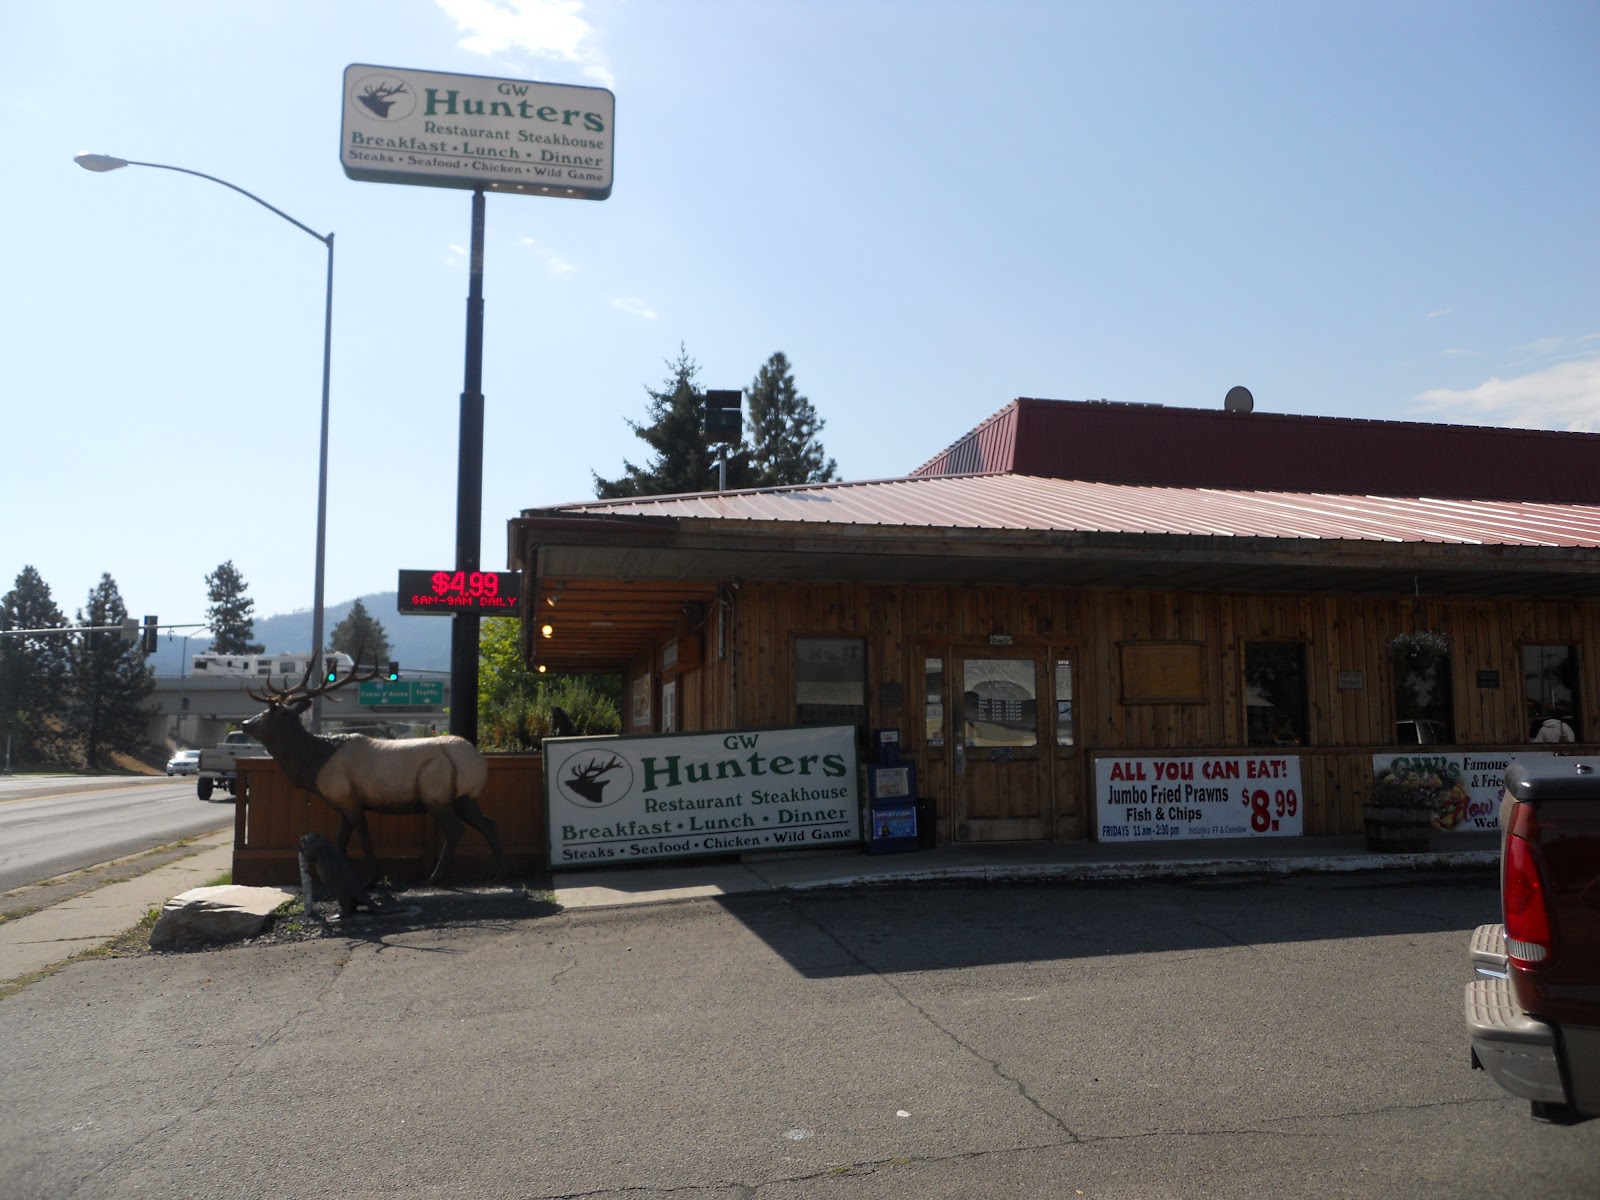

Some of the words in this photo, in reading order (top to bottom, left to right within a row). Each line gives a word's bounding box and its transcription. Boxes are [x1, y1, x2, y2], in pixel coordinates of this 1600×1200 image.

[497, 82, 530, 97] GW
[423, 87, 605, 133] Hunters
[424, 121, 511, 141] Restaurant
[518, 129, 604, 150] Steakhouse
[351, 131, 447, 152] Breakfast
[463, 142, 519, 159] Lunch
[541, 149, 603, 167] Dinner
[348, 149, 394, 163] Steaks
[407, 155, 460, 169] Seafood
[472, 160, 522, 174] Chicken
[534, 167, 562, 179] Wild
[567, 169, 603, 182] Game
[431, 570, 499, 597] $4.99
[411, 595, 473, 606] 6AM-9AM
[480, 596, 517, 607] DAILY
[723, 734, 760, 750] GW
[640, 751, 847, 793] Hunters
[1109, 761, 1147, 782] ALL
[1153, 761, 1195, 781] YOU
[1202, 760, 1240, 780] CAN
[1246, 760, 1288, 779] EAT!
[1390, 756, 1461, 779] GW's
[1463, 757, 1508, 771] Famous
[1471, 774, 1479, 788] &
[644, 793, 743, 814] Restaurant
[751, 785, 848, 805] Steakhouse
[1107, 784, 1148, 805] Jumbo
[1151, 784, 1182, 804] Fried
[1185, 783, 1229, 803] Prawns
[561, 820, 672, 841] Breakfast
[689, 812, 755, 833] Lunch
[778, 807, 847, 824] Dinner
[1126, 807, 1152, 822] Fish
[1155, 808, 1165, 821] &
[1168, 806, 1202, 822] Chips
[1102, 825, 1130, 837] FRIDAYS
[1133, 825, 1141, 836] 11
[1170, 827, 1180, 837] pm
[562, 846, 615, 861] Steaks
[630, 840, 690, 856] Seafood
[703, 835, 760, 850] Chicken
[773, 830, 806, 843] Wild
[812, 827, 852, 840] Game
